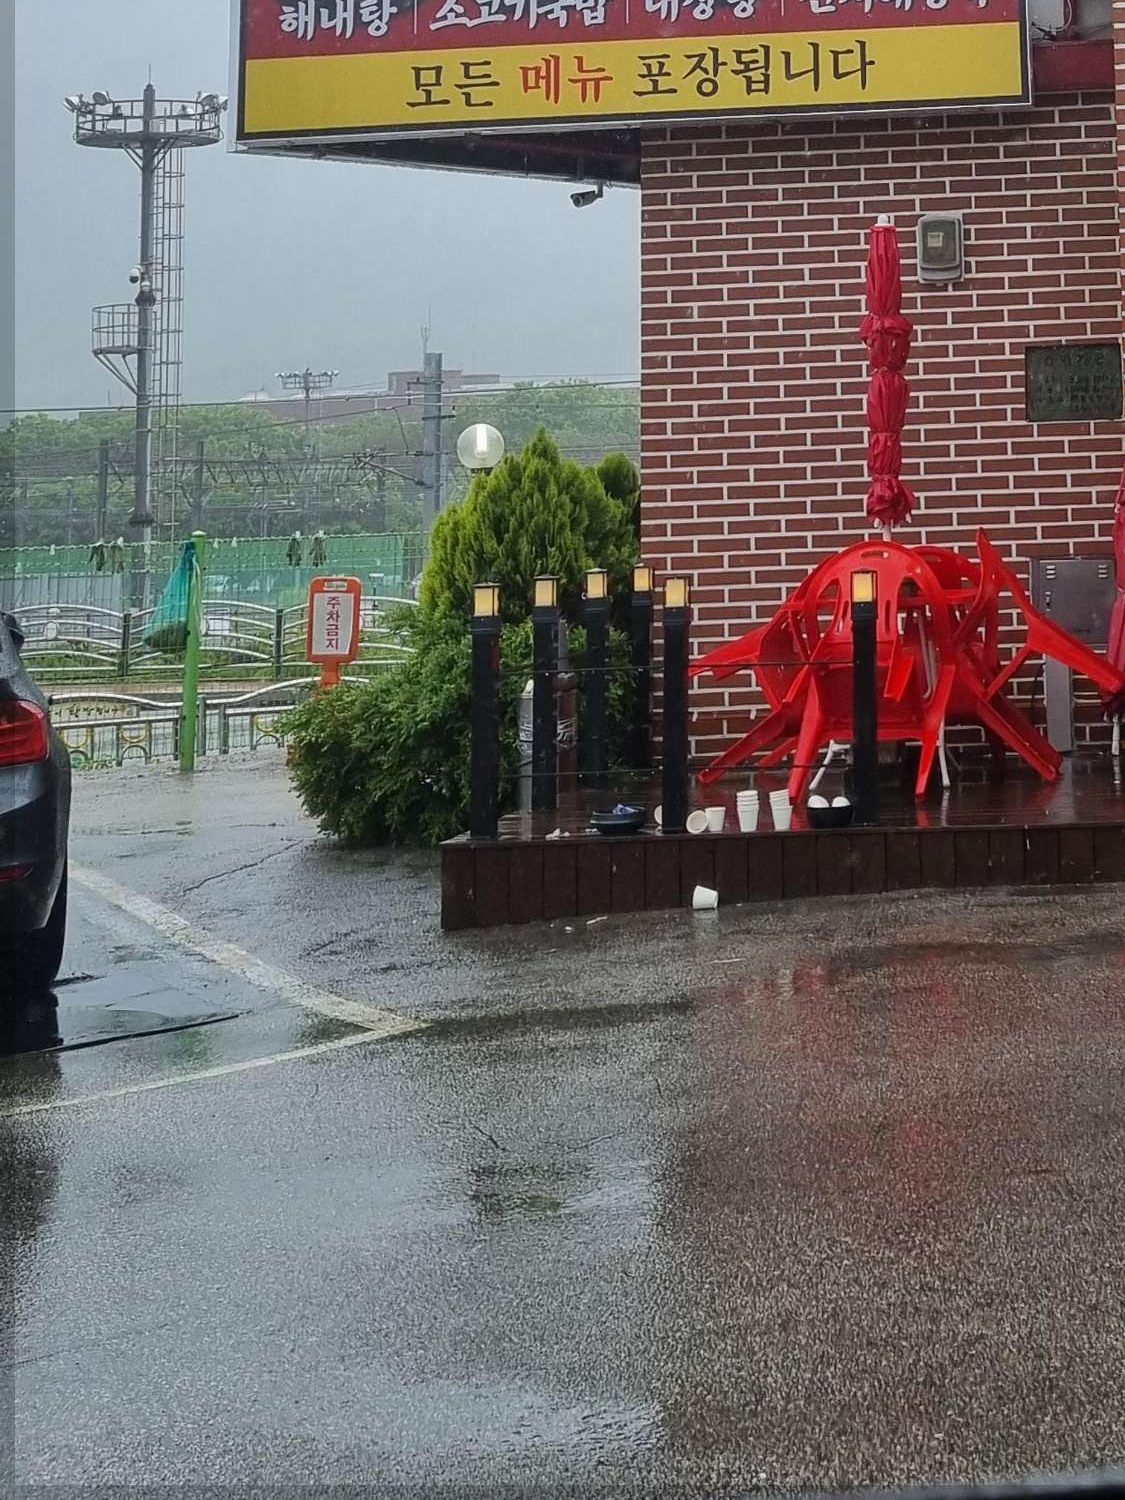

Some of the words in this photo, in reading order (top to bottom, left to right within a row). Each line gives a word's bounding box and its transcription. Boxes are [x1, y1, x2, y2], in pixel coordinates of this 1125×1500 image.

[404, 60, 501, 110] 모든
[517, 52, 614, 105] 메뉴
[632, 39, 877, 99] 포장됩니다
[326, 596, 342, 651] 주차금지
